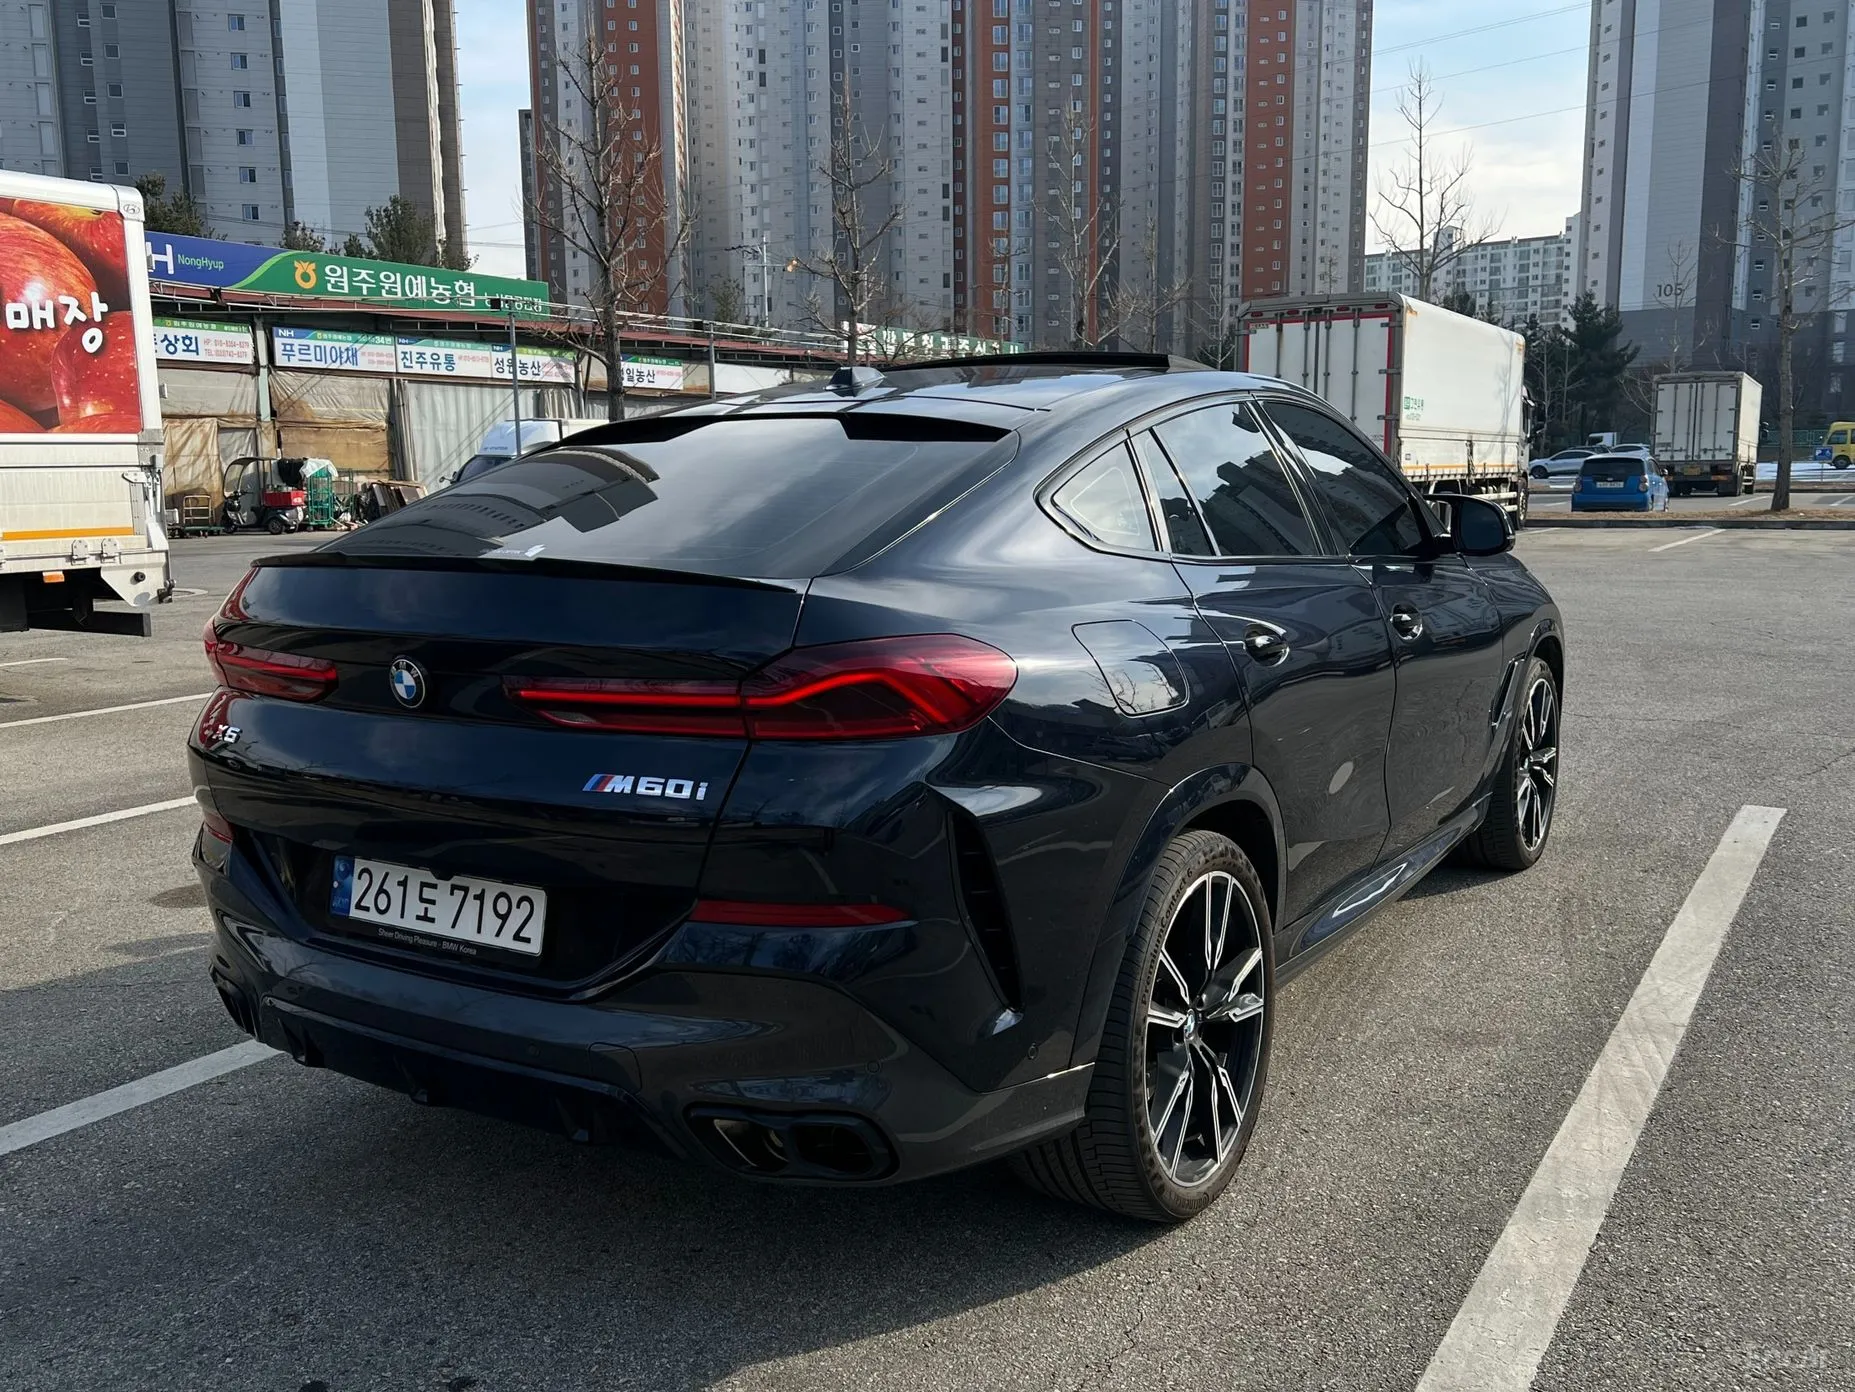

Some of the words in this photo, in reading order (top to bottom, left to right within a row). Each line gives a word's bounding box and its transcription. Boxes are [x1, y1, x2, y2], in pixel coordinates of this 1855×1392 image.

[177, 254, 225, 271] NongHyup
[325, 264, 475, 308] 원주원예농협
[1657, 283, 1683, 297] 105
[5, 291, 109, 354] 매장
[278, 329, 295, 337] NH
[153, 333, 200, 356] 상회
[281, 343, 359, 366] 푸르미야채
[400, 350, 456, 372] 진주유통
[621, 367, 656, 384] 일농산
[590, 774, 708, 800] M60i
[378, 927, 394, 938] Sheer
[394, 931, 413, 945] Driving
[413, 935, 438, 948] Pleasure
[441, 940, 459, 952] BMW
[459, 944, 477, 955] Korea
[1141, 877, 1187, 1006] PremiumContact
